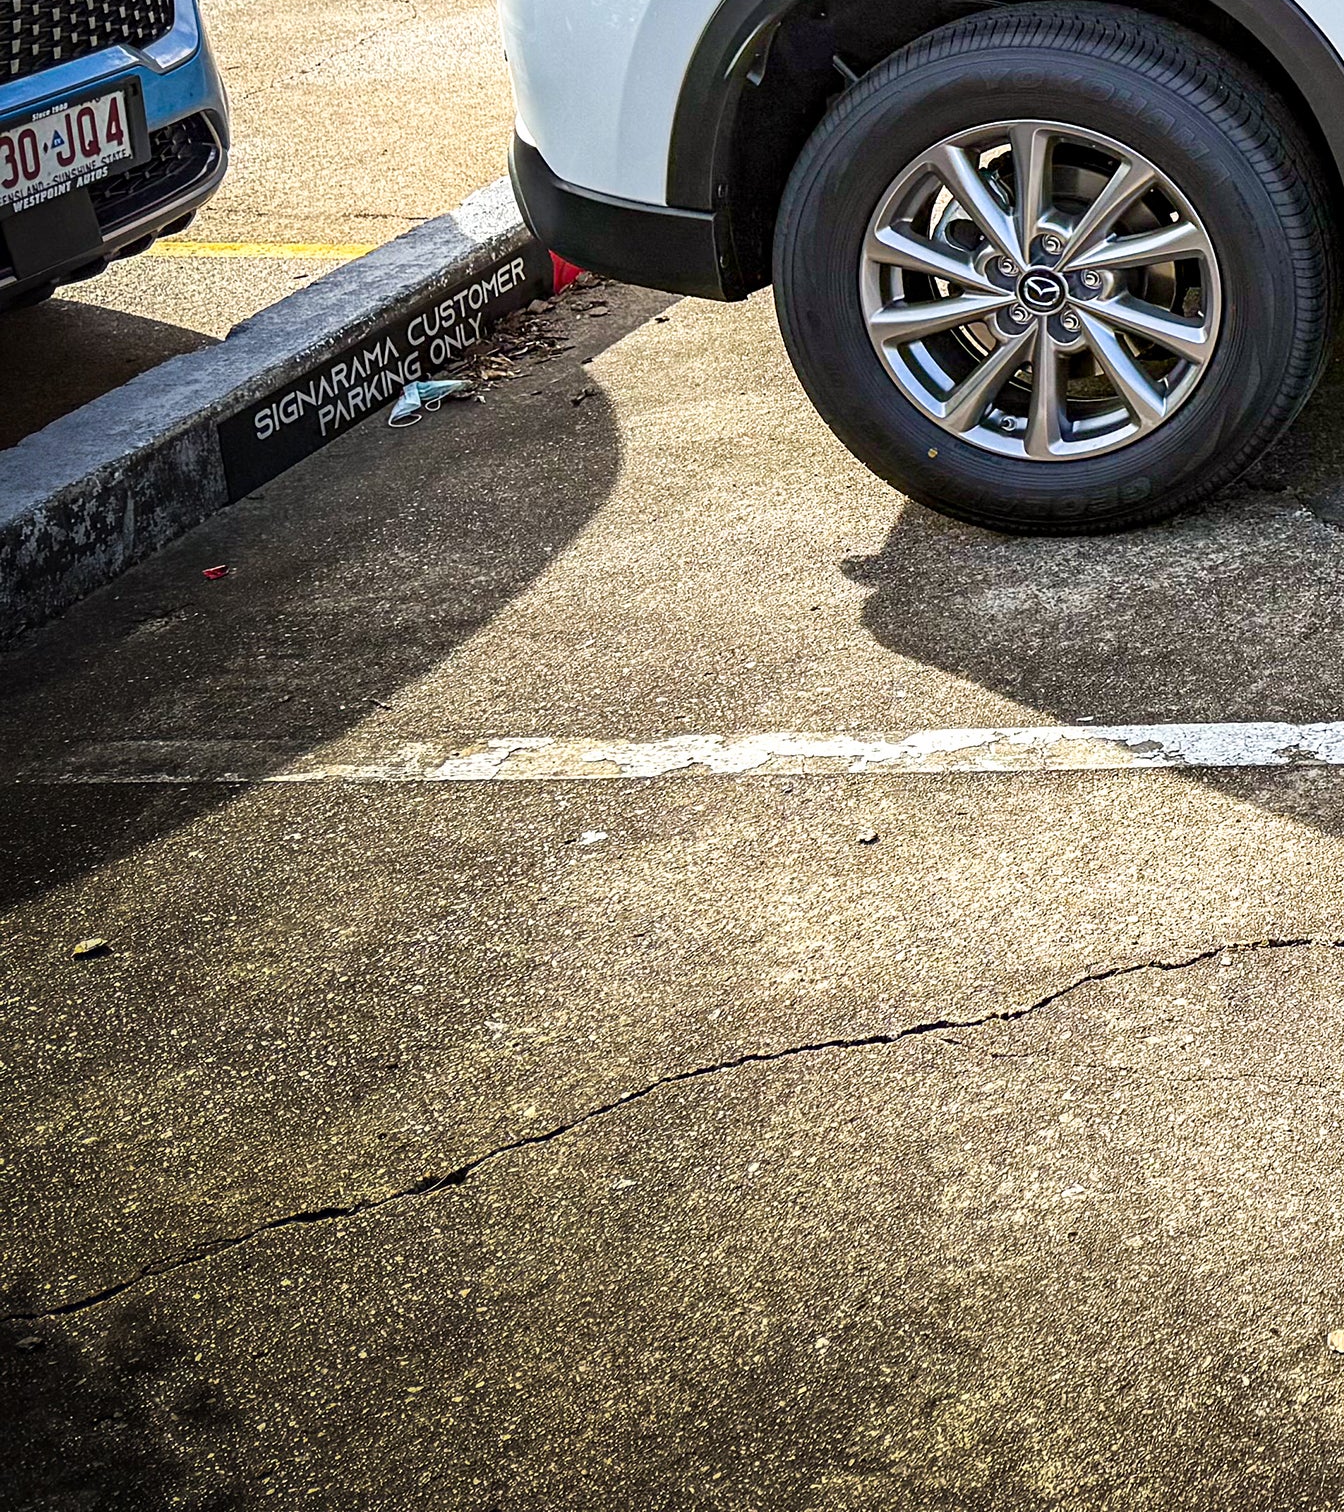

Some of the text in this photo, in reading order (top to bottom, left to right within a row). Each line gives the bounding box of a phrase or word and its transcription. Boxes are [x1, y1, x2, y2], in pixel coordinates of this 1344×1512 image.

[12, 166, 109, 213] WESTPOINT AUTOS
[254, 256, 526, 441] SIGNARAMA CUSTOMER
[318, 313, 487, 437] PARKING ONLY
